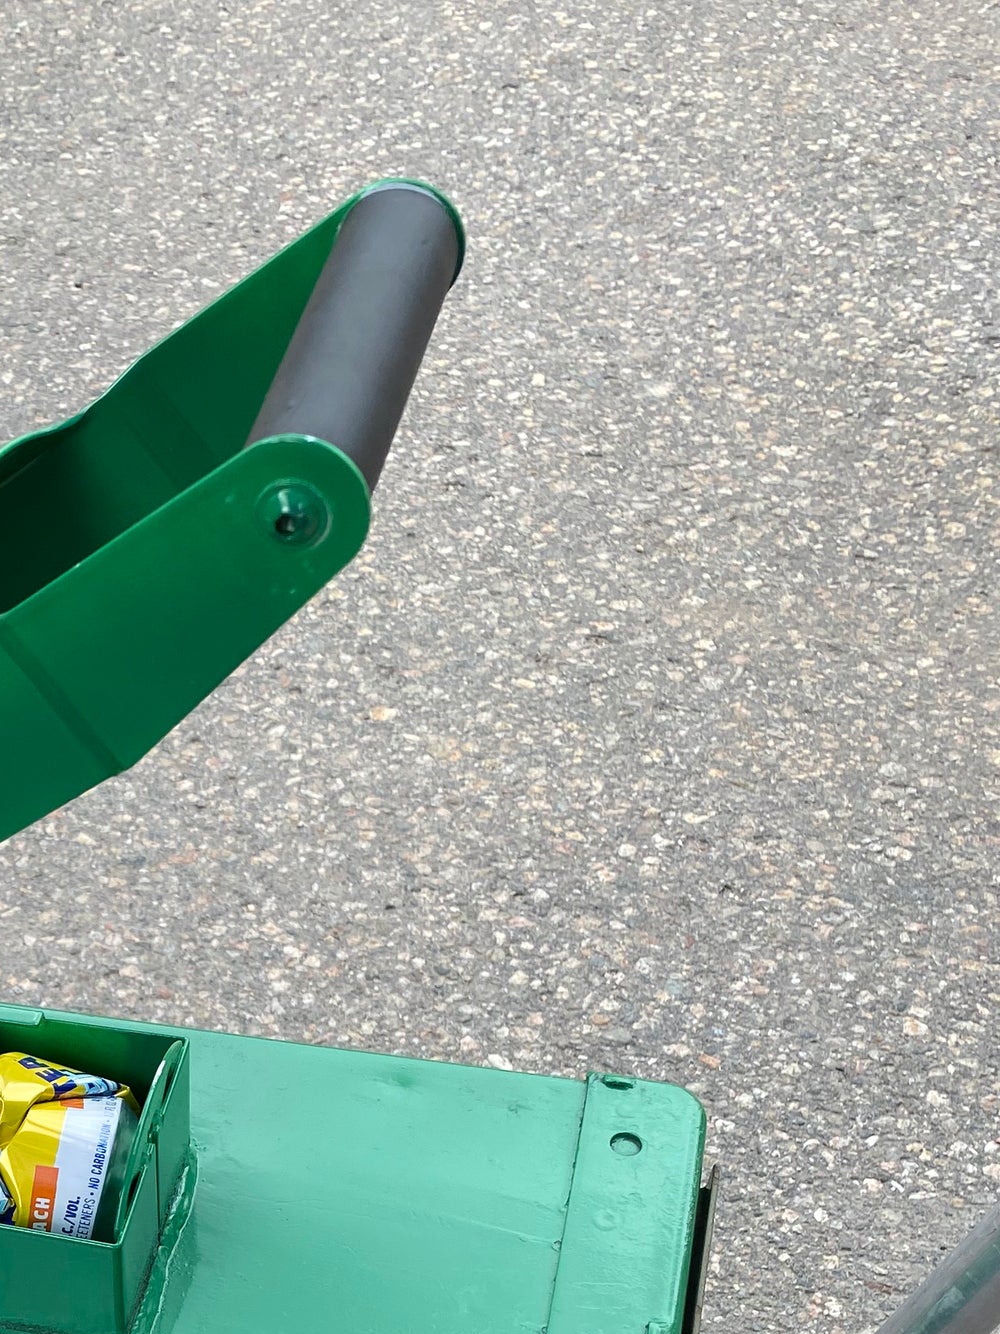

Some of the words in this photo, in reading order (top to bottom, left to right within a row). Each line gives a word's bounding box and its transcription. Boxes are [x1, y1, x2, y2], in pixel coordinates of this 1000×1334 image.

[91, 1124, 111, 1176] CARBONATION
[88, 1177, 101, 1190] NO
[32, 1197, 51, 1231] ACH
[62, 1196, 81, 1235] C./VOL.
[76, 1198, 96, 1239] EETENERS
